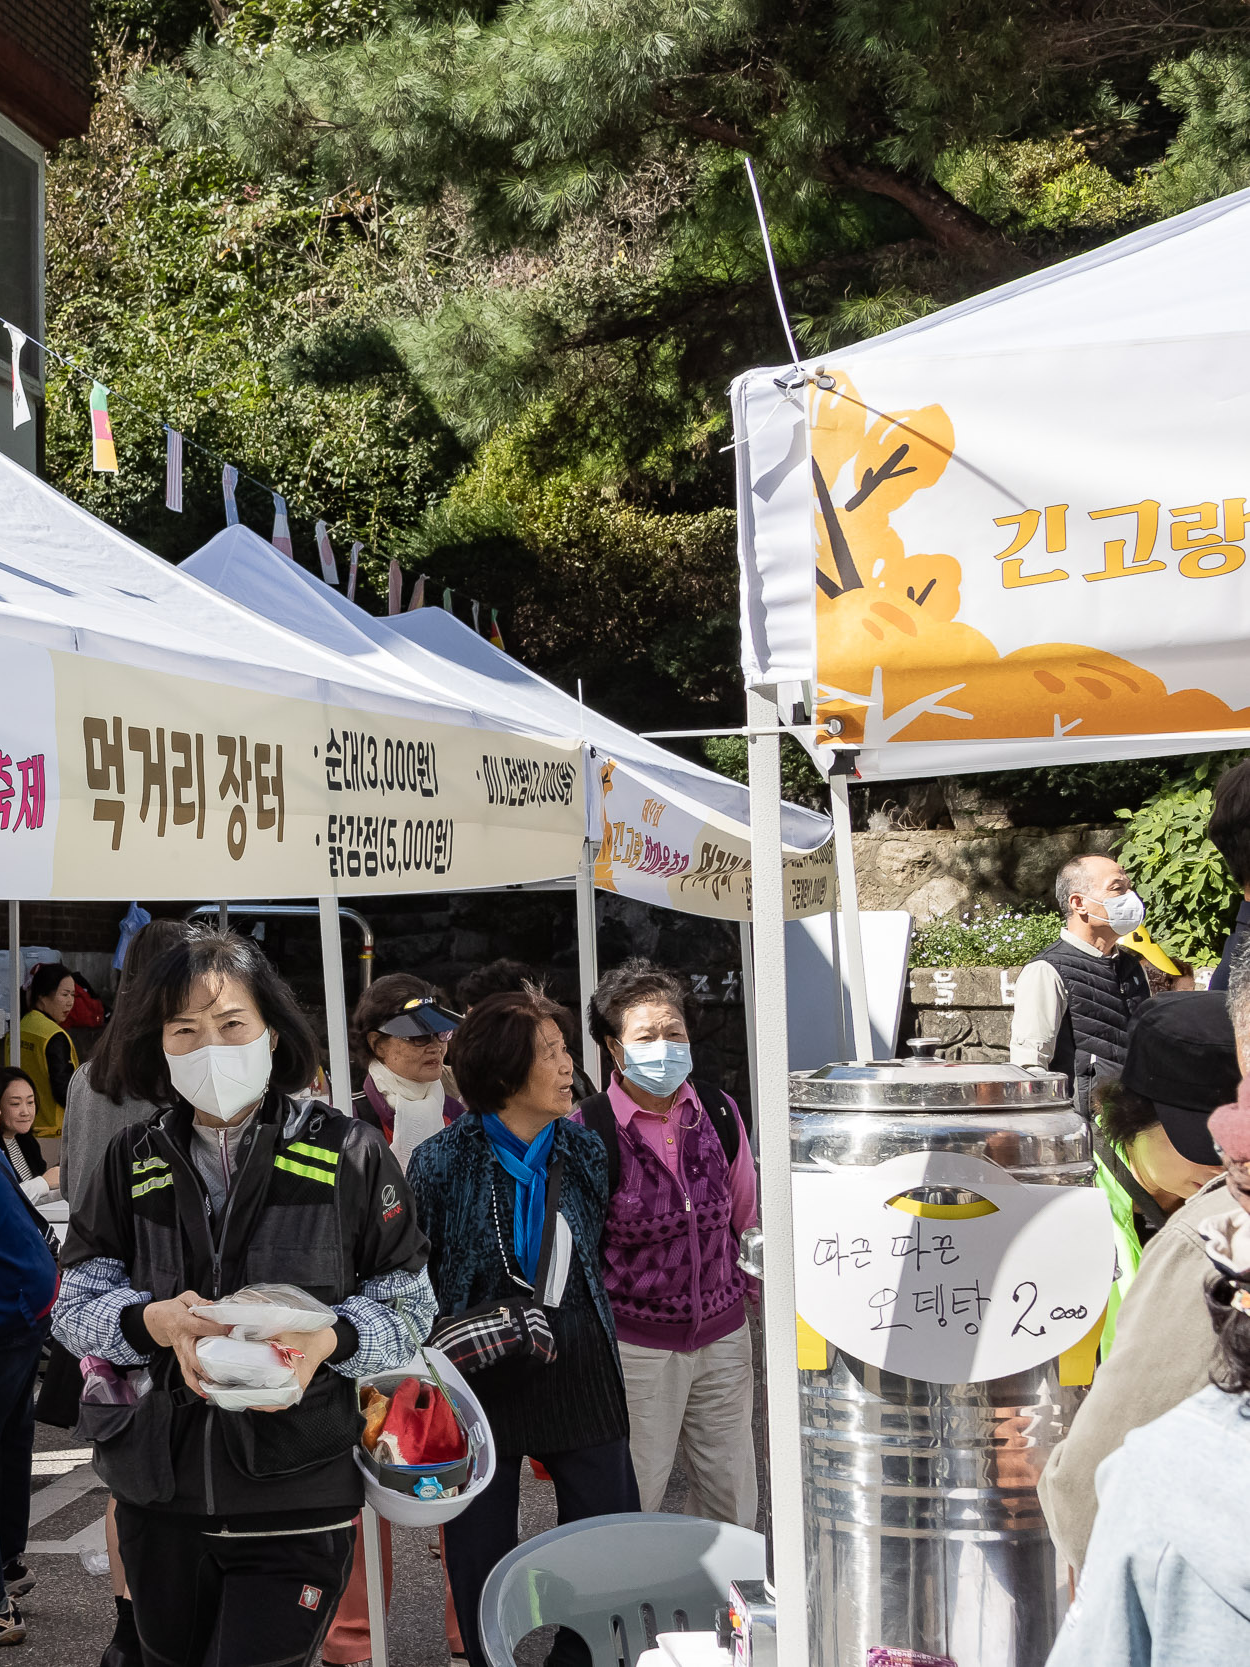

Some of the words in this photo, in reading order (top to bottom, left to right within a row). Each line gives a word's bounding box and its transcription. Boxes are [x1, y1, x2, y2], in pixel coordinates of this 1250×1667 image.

[993, 498, 1250, 590] 긴고랑
[83, 716, 206, 851] 먹거리
[217, 735, 285, 861] 장터
[325, 728, 439, 798] 순대(3,000원)
